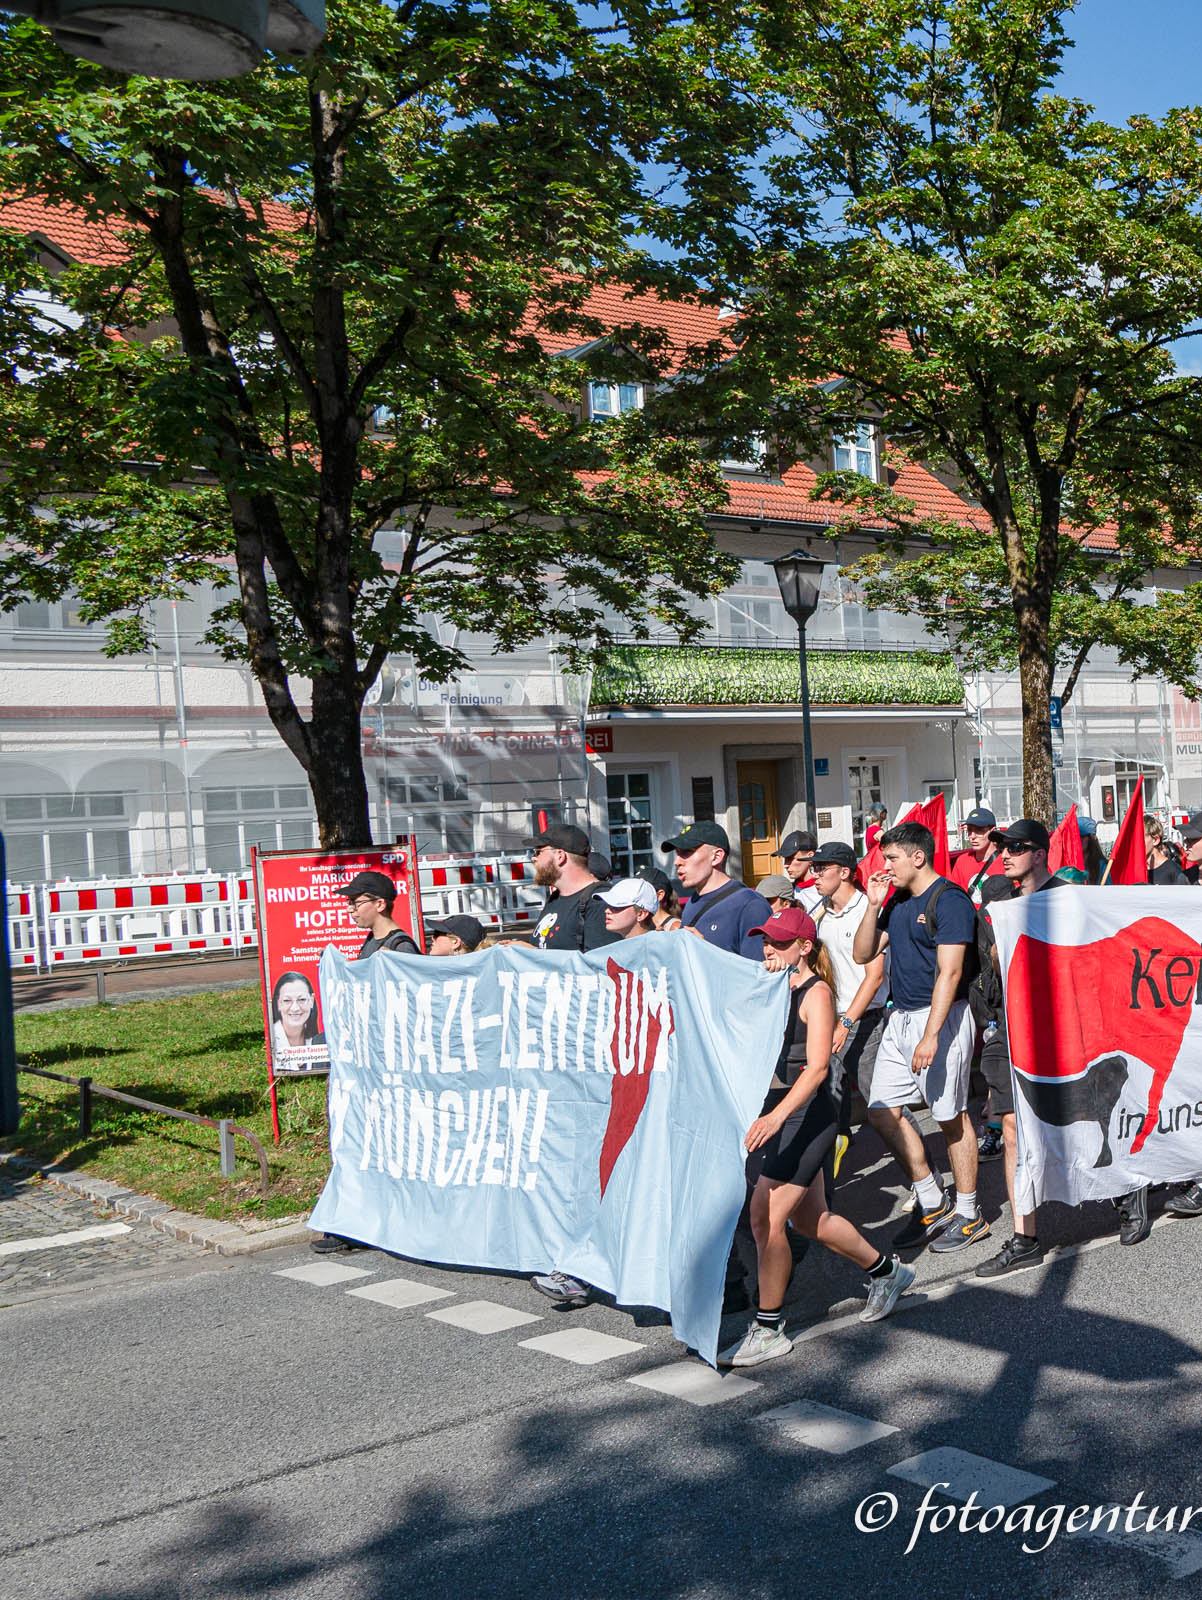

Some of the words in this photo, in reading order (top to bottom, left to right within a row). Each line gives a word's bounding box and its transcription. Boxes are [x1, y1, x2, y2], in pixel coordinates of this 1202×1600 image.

[418, 680, 439, 692] Die
[382, 853, 405, 864] SPD
[383, 966, 672, 1077] NAZI-ZENTRUM
[359, 1072, 550, 1191] MÜNCHEN!
[1117, 1106, 1147, 1140] in
